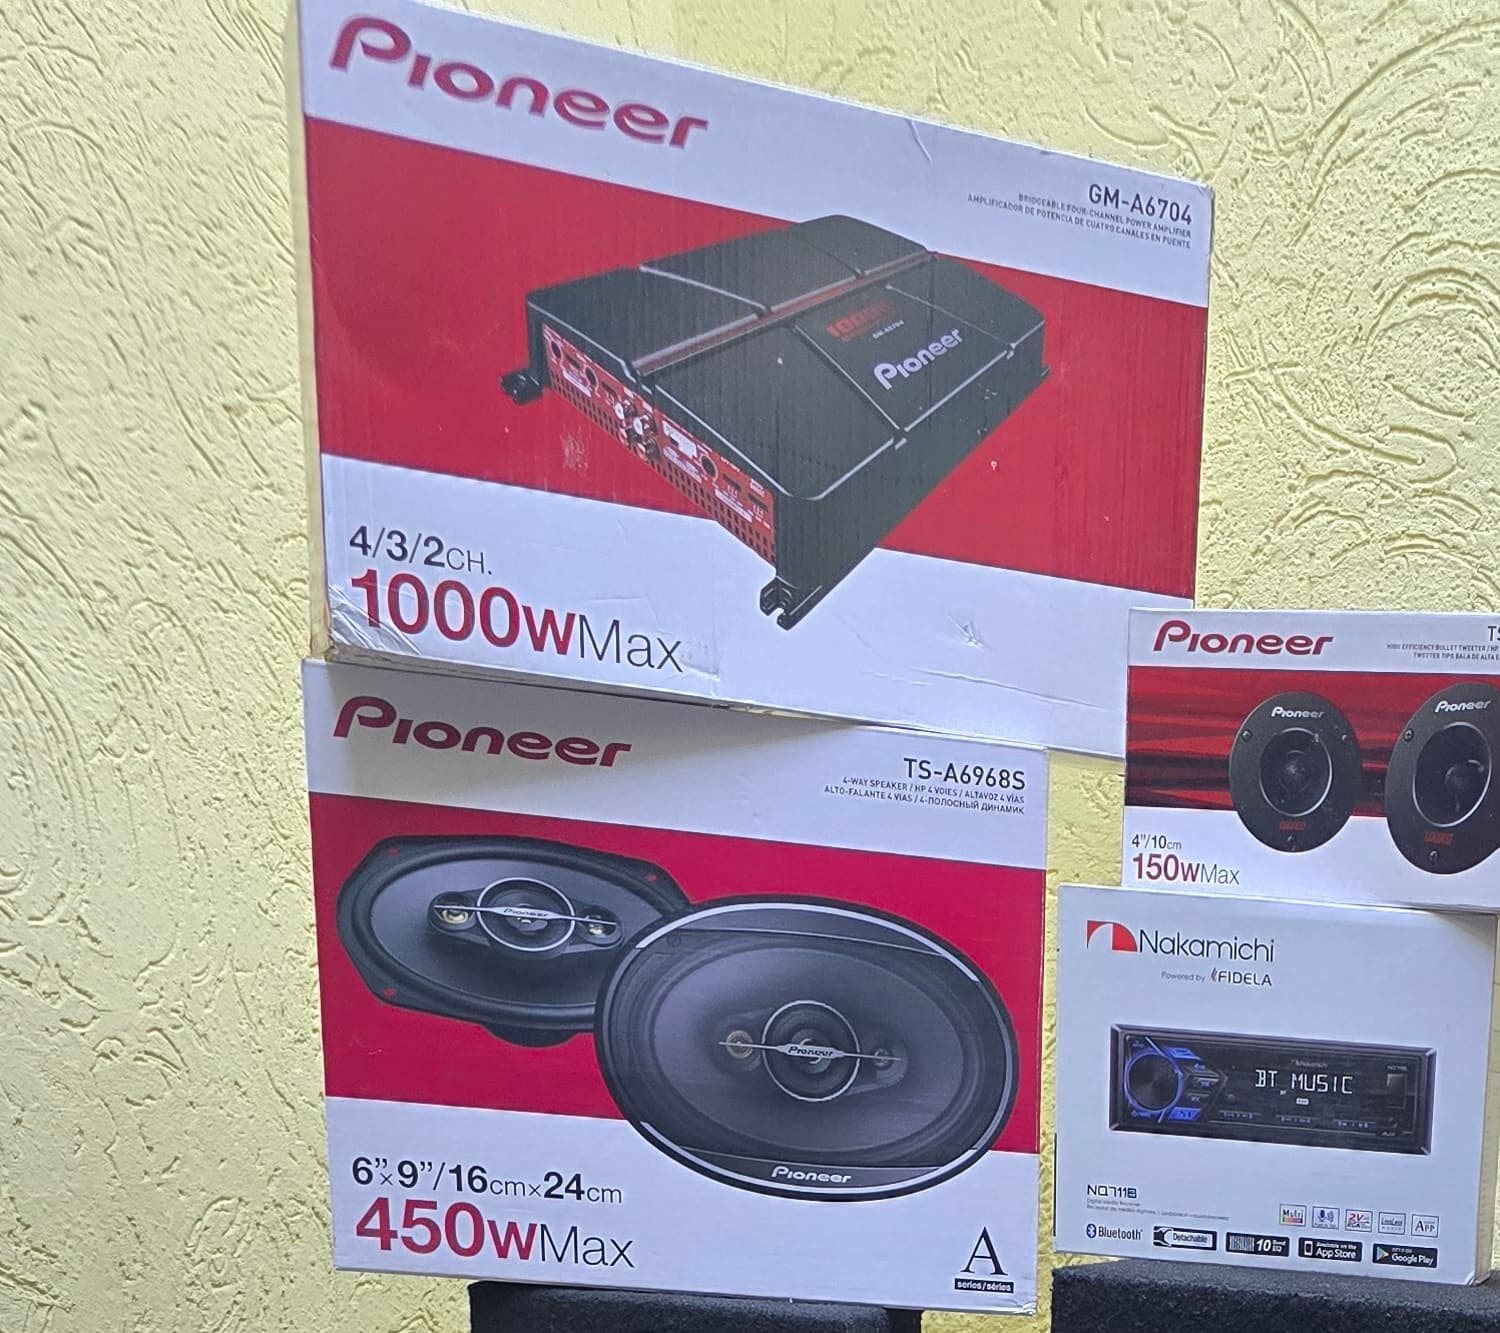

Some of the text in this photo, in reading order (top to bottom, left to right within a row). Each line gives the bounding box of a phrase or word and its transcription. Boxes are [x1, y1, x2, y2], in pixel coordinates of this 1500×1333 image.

[328, 15, 710, 150] Pioneer
[1088, 183, 1192, 225] GM-A6704
[967, 193, 1191, 249] AMPLIFICADOR DE POTENCIA DE CUATRO CANALES EN PUENTE
[1067, 204, 1123, 224] FOUR-CHANNEL
[1126, 217, 1151, 229] POWER
[1153, 222, 1191, 239] AMPLIFIER
[873, 328, 963, 390] Pioneer
[1153, 620, 1335, 655] Pioneer
[1271, 706, 1325, 718] Pioneer
[1434, 700, 1492, 713] Pioneer
[333, 695, 632, 767] Pioneer
[903, 757, 1025, 790] TS-A6968S
[824, 785, 886, 800] ALTO-FALANTE
[981, 802, 1025, 814] ДИНАМИК
[842, 776, 869, 786] 4-WAY
[870, 780, 907, 790] SPEAKER
[934, 787, 957, 796] VOIES
[965, 790, 998, 800] ALTAVOZ
[503, 908, 549, 917] Pioneer
[1139, 928, 1274, 962] Nakamichi
[1161, 970, 1272, 987] Powered by FIDELA
[788, 1046, 833, 1057] Pioneer
[1255, 1069, 1353, 1094] BT MUSIC
[772, 1166, 851, 1183] Pioneer
[1087, 1184, 1137, 1198] NQ711B
[1098, 1226, 1141, 1240] Bluetooth
[1257, 1239, 1271, 1251] 10
[960, 1226, 1008, 1276] A
[1317, 1248, 1356, 1259] App Store
[1392, 1253, 1434, 1265] Google Play
